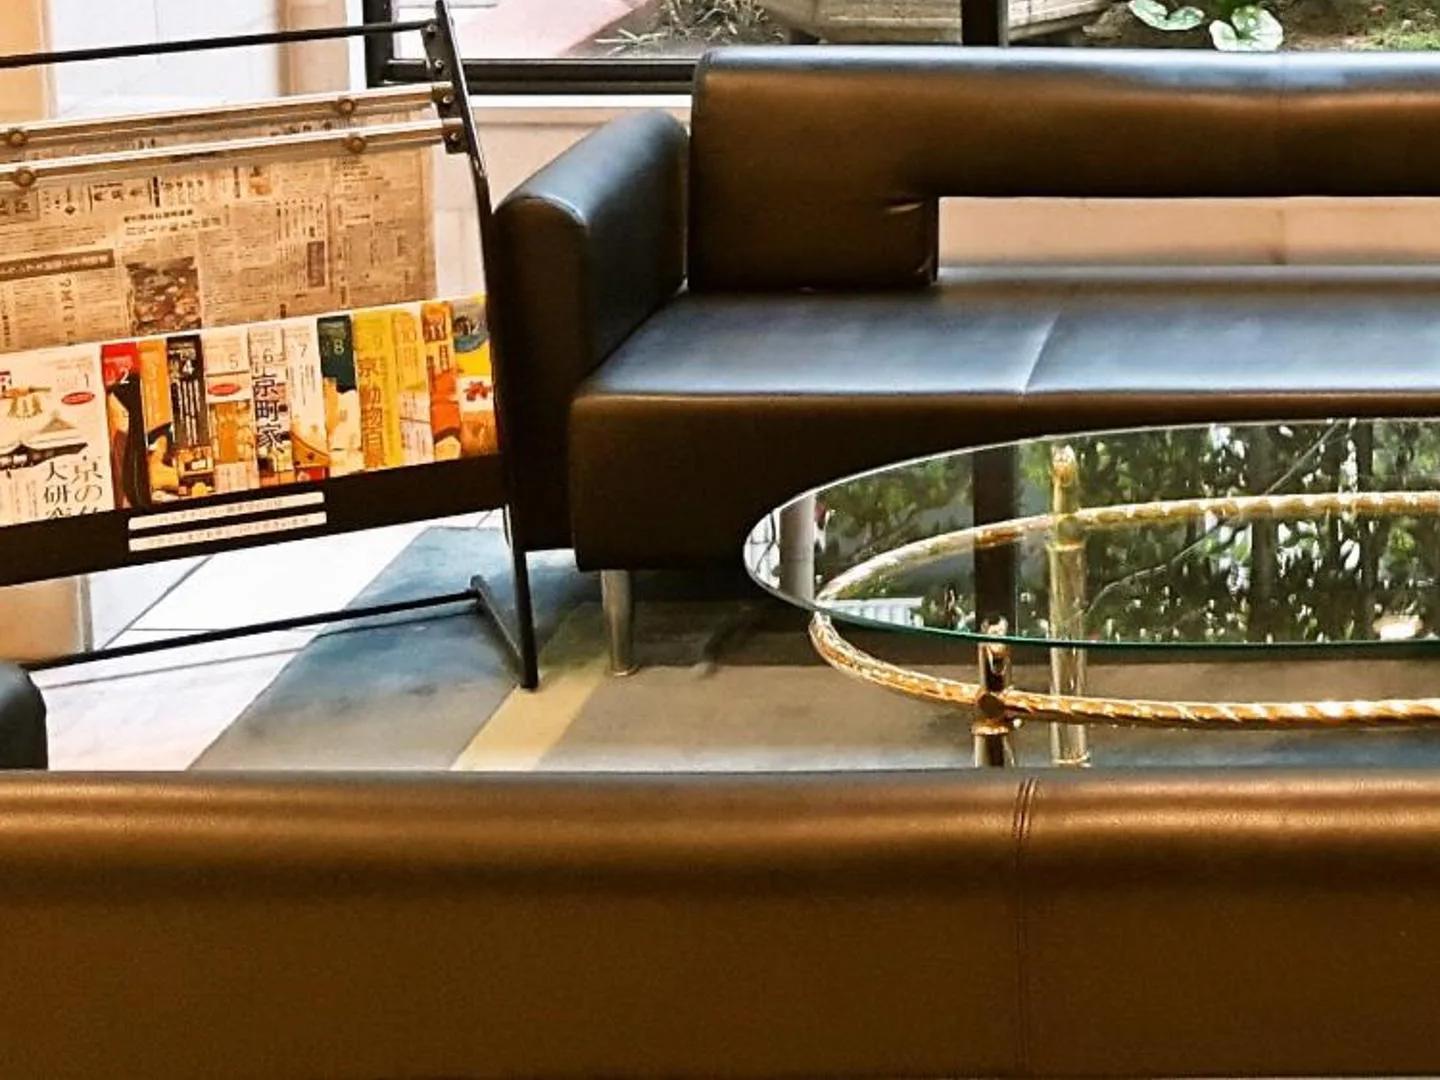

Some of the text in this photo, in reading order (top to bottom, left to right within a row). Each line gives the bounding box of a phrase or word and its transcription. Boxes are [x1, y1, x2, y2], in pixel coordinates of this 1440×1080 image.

[333, 338, 345, 355] 8
[262, 347, 274, 364] 6
[119, 366, 130, 384] 2
[182, 359, 194, 375] 4
[252, 365, 285, 454] 京町家
